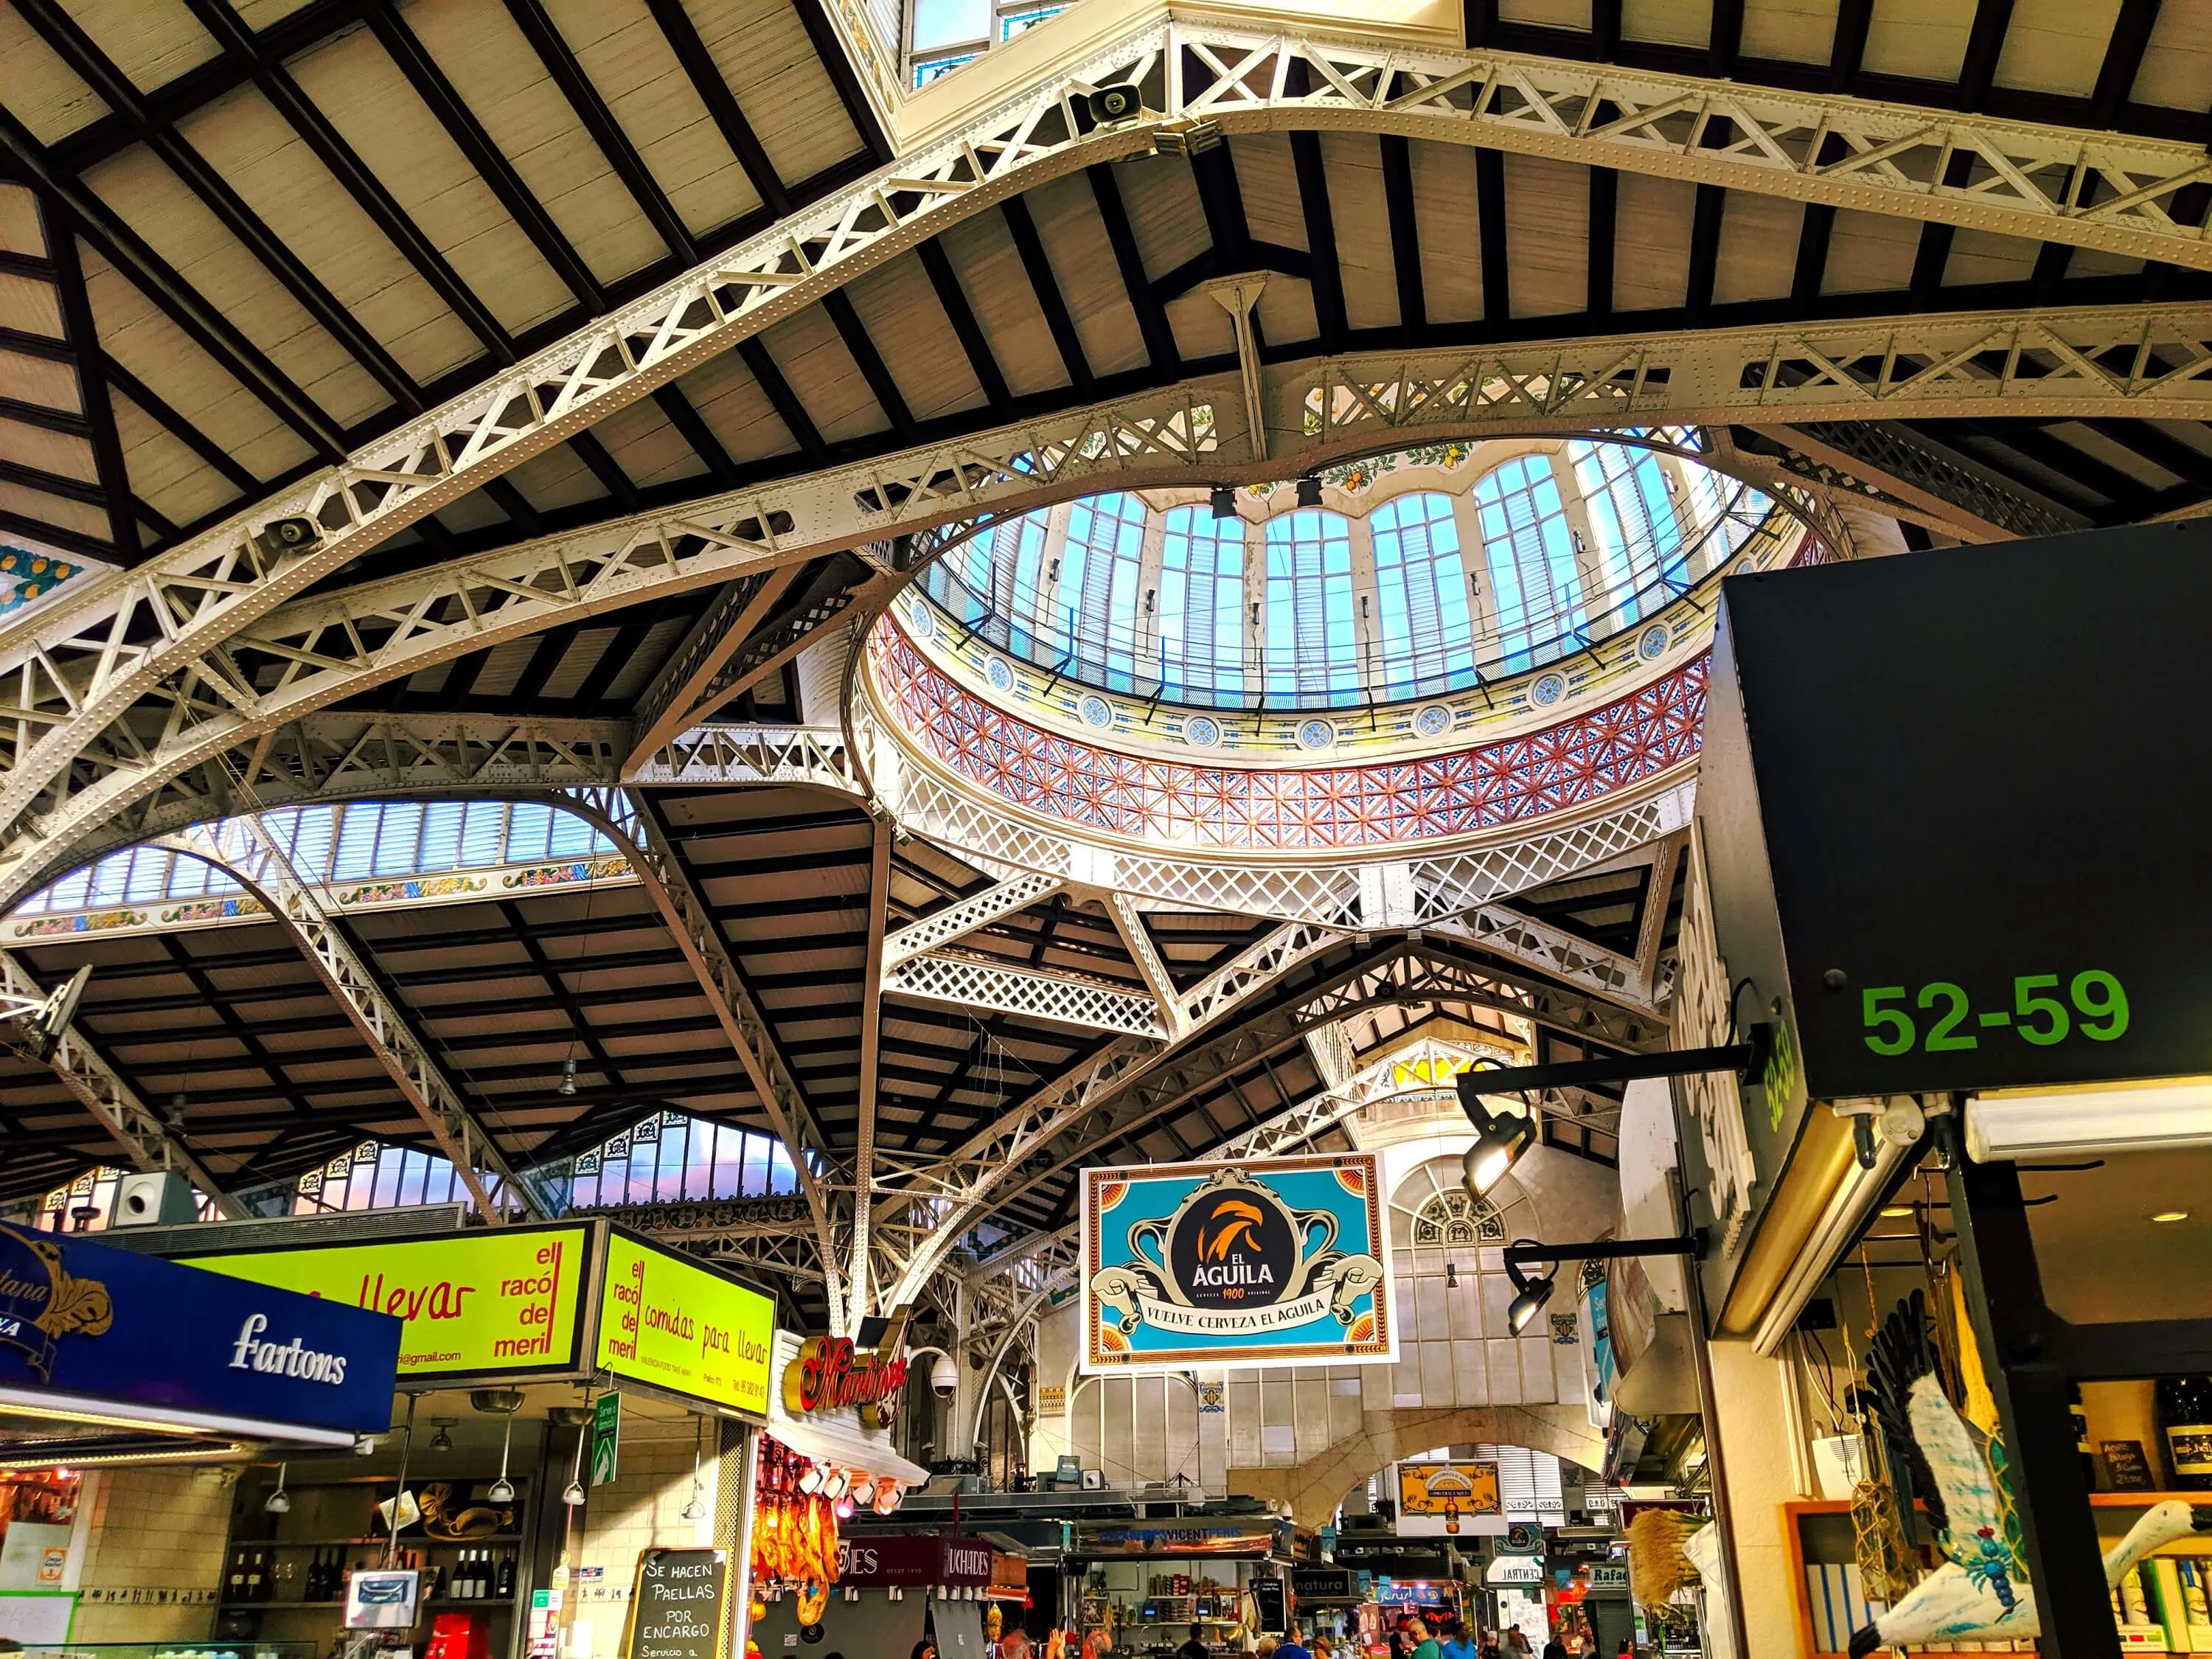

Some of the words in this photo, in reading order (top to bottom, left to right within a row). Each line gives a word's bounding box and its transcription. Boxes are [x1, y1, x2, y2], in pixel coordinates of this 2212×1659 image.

[1863, 969, 2129, 1056] 52-59
[1764, 1020, 1795, 1133] 52-59
[1232, 1253, 1245, 1265] EL
[501, 1270, 552, 1297] racó
[1192, 1264, 1275, 1287] ÁGUILA
[359, 1273, 476, 1321] llevar
[613, 1283, 638, 1305] racó
[1222, 1288, 1245, 1299] 1900
[519, 1303, 548, 1325] de
[622, 1311, 636, 1332] de
[1147, 1307, 1194, 1326] VUELVE
[1198, 1316, 1257, 1329] CERVEZA
[1261, 1313, 1275, 1326] EL
[1278, 1298, 1325, 1323] ÁGUILA
[645, 1299, 694, 1340] comidas
[702, 1324, 729, 1359] para
[737, 1329, 768, 1364] llevar
[229, 1313, 347, 1385] fartons
[1169, 1528, 1208, 1540] VICENT
[647, 1562, 665, 1577] SE
[671, 1564, 712, 1578] HACEN
[651, 1584, 715, 1601] PAELLAS
[1295, 1580, 1343, 1591] natura
[666, 1610, 693, 1623] POR
[643, 1624, 709, 1638] ENCARGO
[641, 1645, 682, 1658] Servicio
